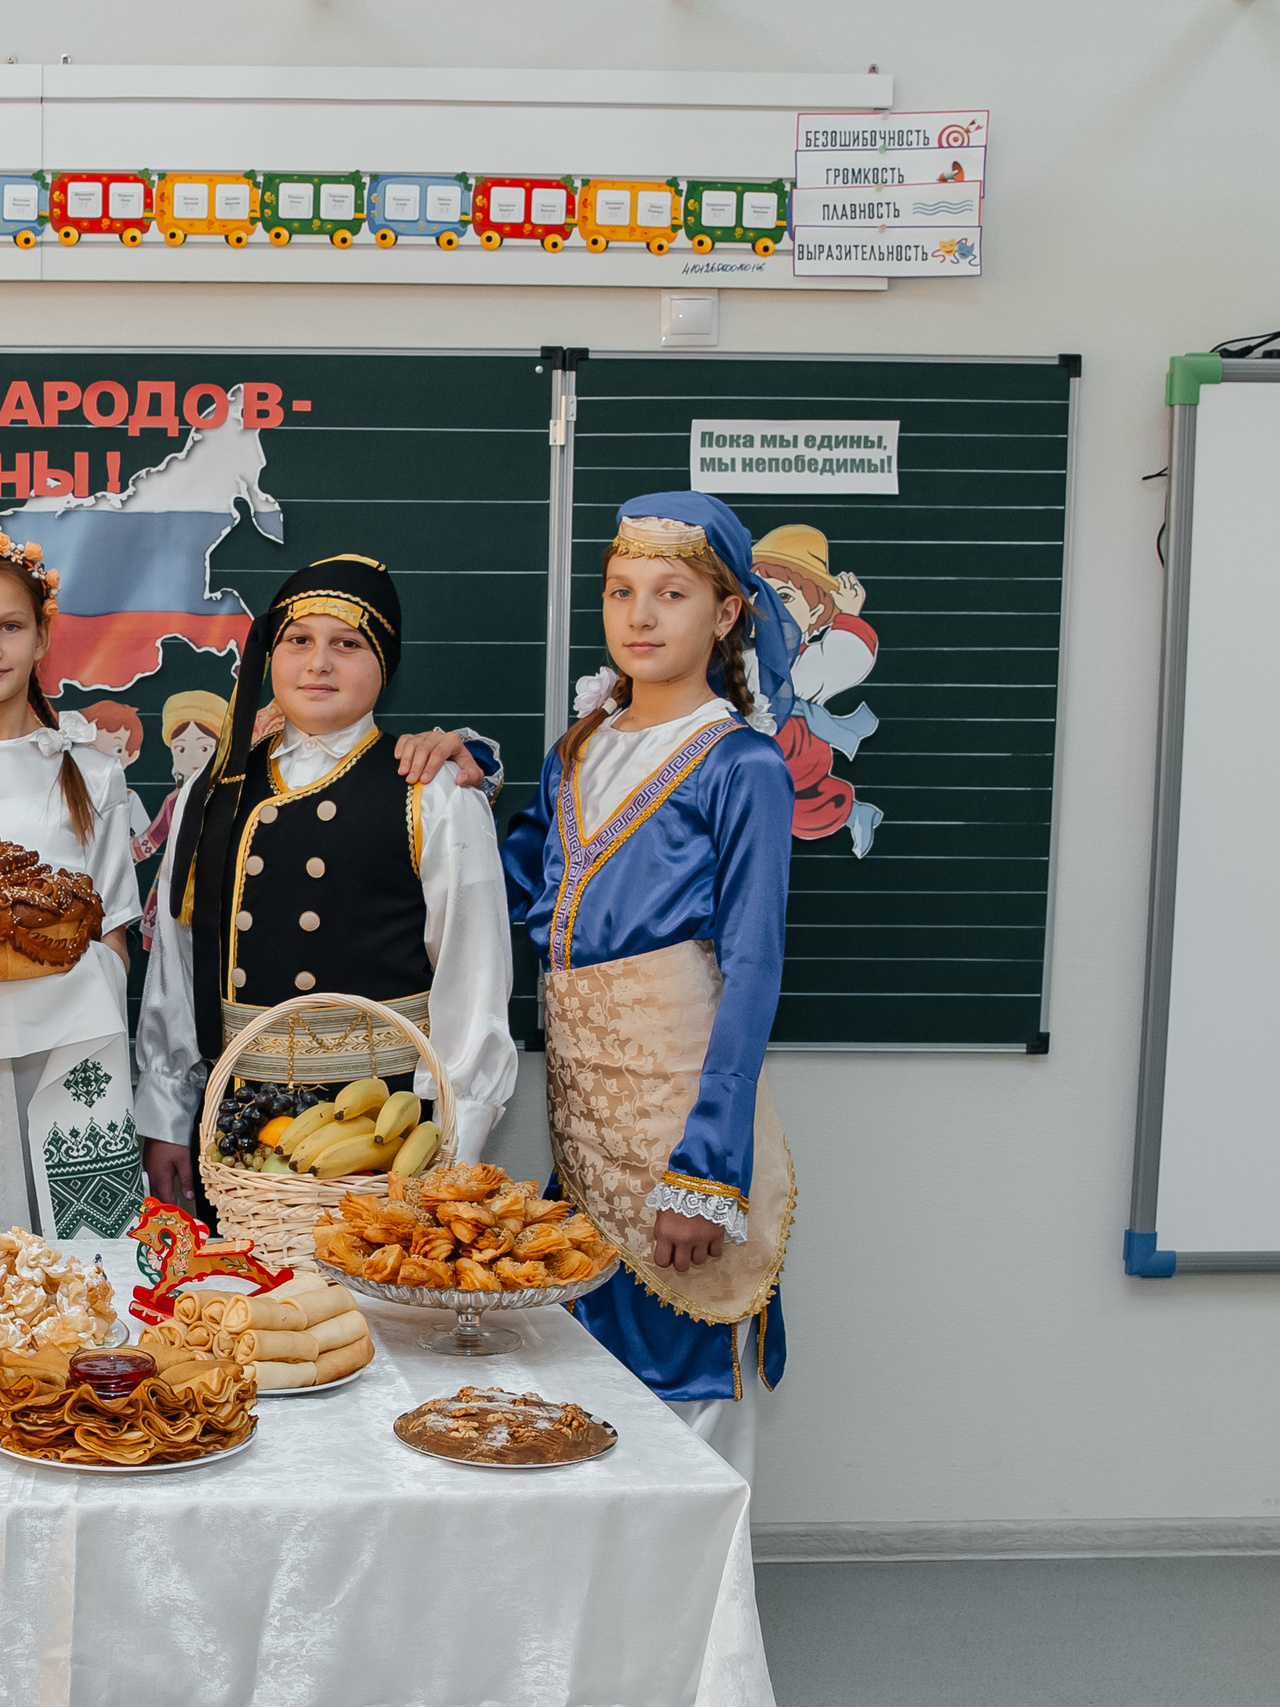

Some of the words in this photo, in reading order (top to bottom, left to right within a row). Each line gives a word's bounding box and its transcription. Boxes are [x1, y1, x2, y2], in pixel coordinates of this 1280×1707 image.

[805, 129, 930, 148] БЕЗОШИБОЧНОСТЬ
[825, 167, 905, 185] ГРОМКОСТЬ
[822, 201, 900, 221] ПЛАВНОСТЬ
[797, 243, 929, 262] ВЫРАЗИТЕЛЬНОСТЬ
[700, 431, 755, 448] Пока
[760, 434, 799, 449] мы
[804, 435, 888, 451] едины,
[700, 457, 736, 473] мы
[741, 455, 893, 475] непобедимы!
